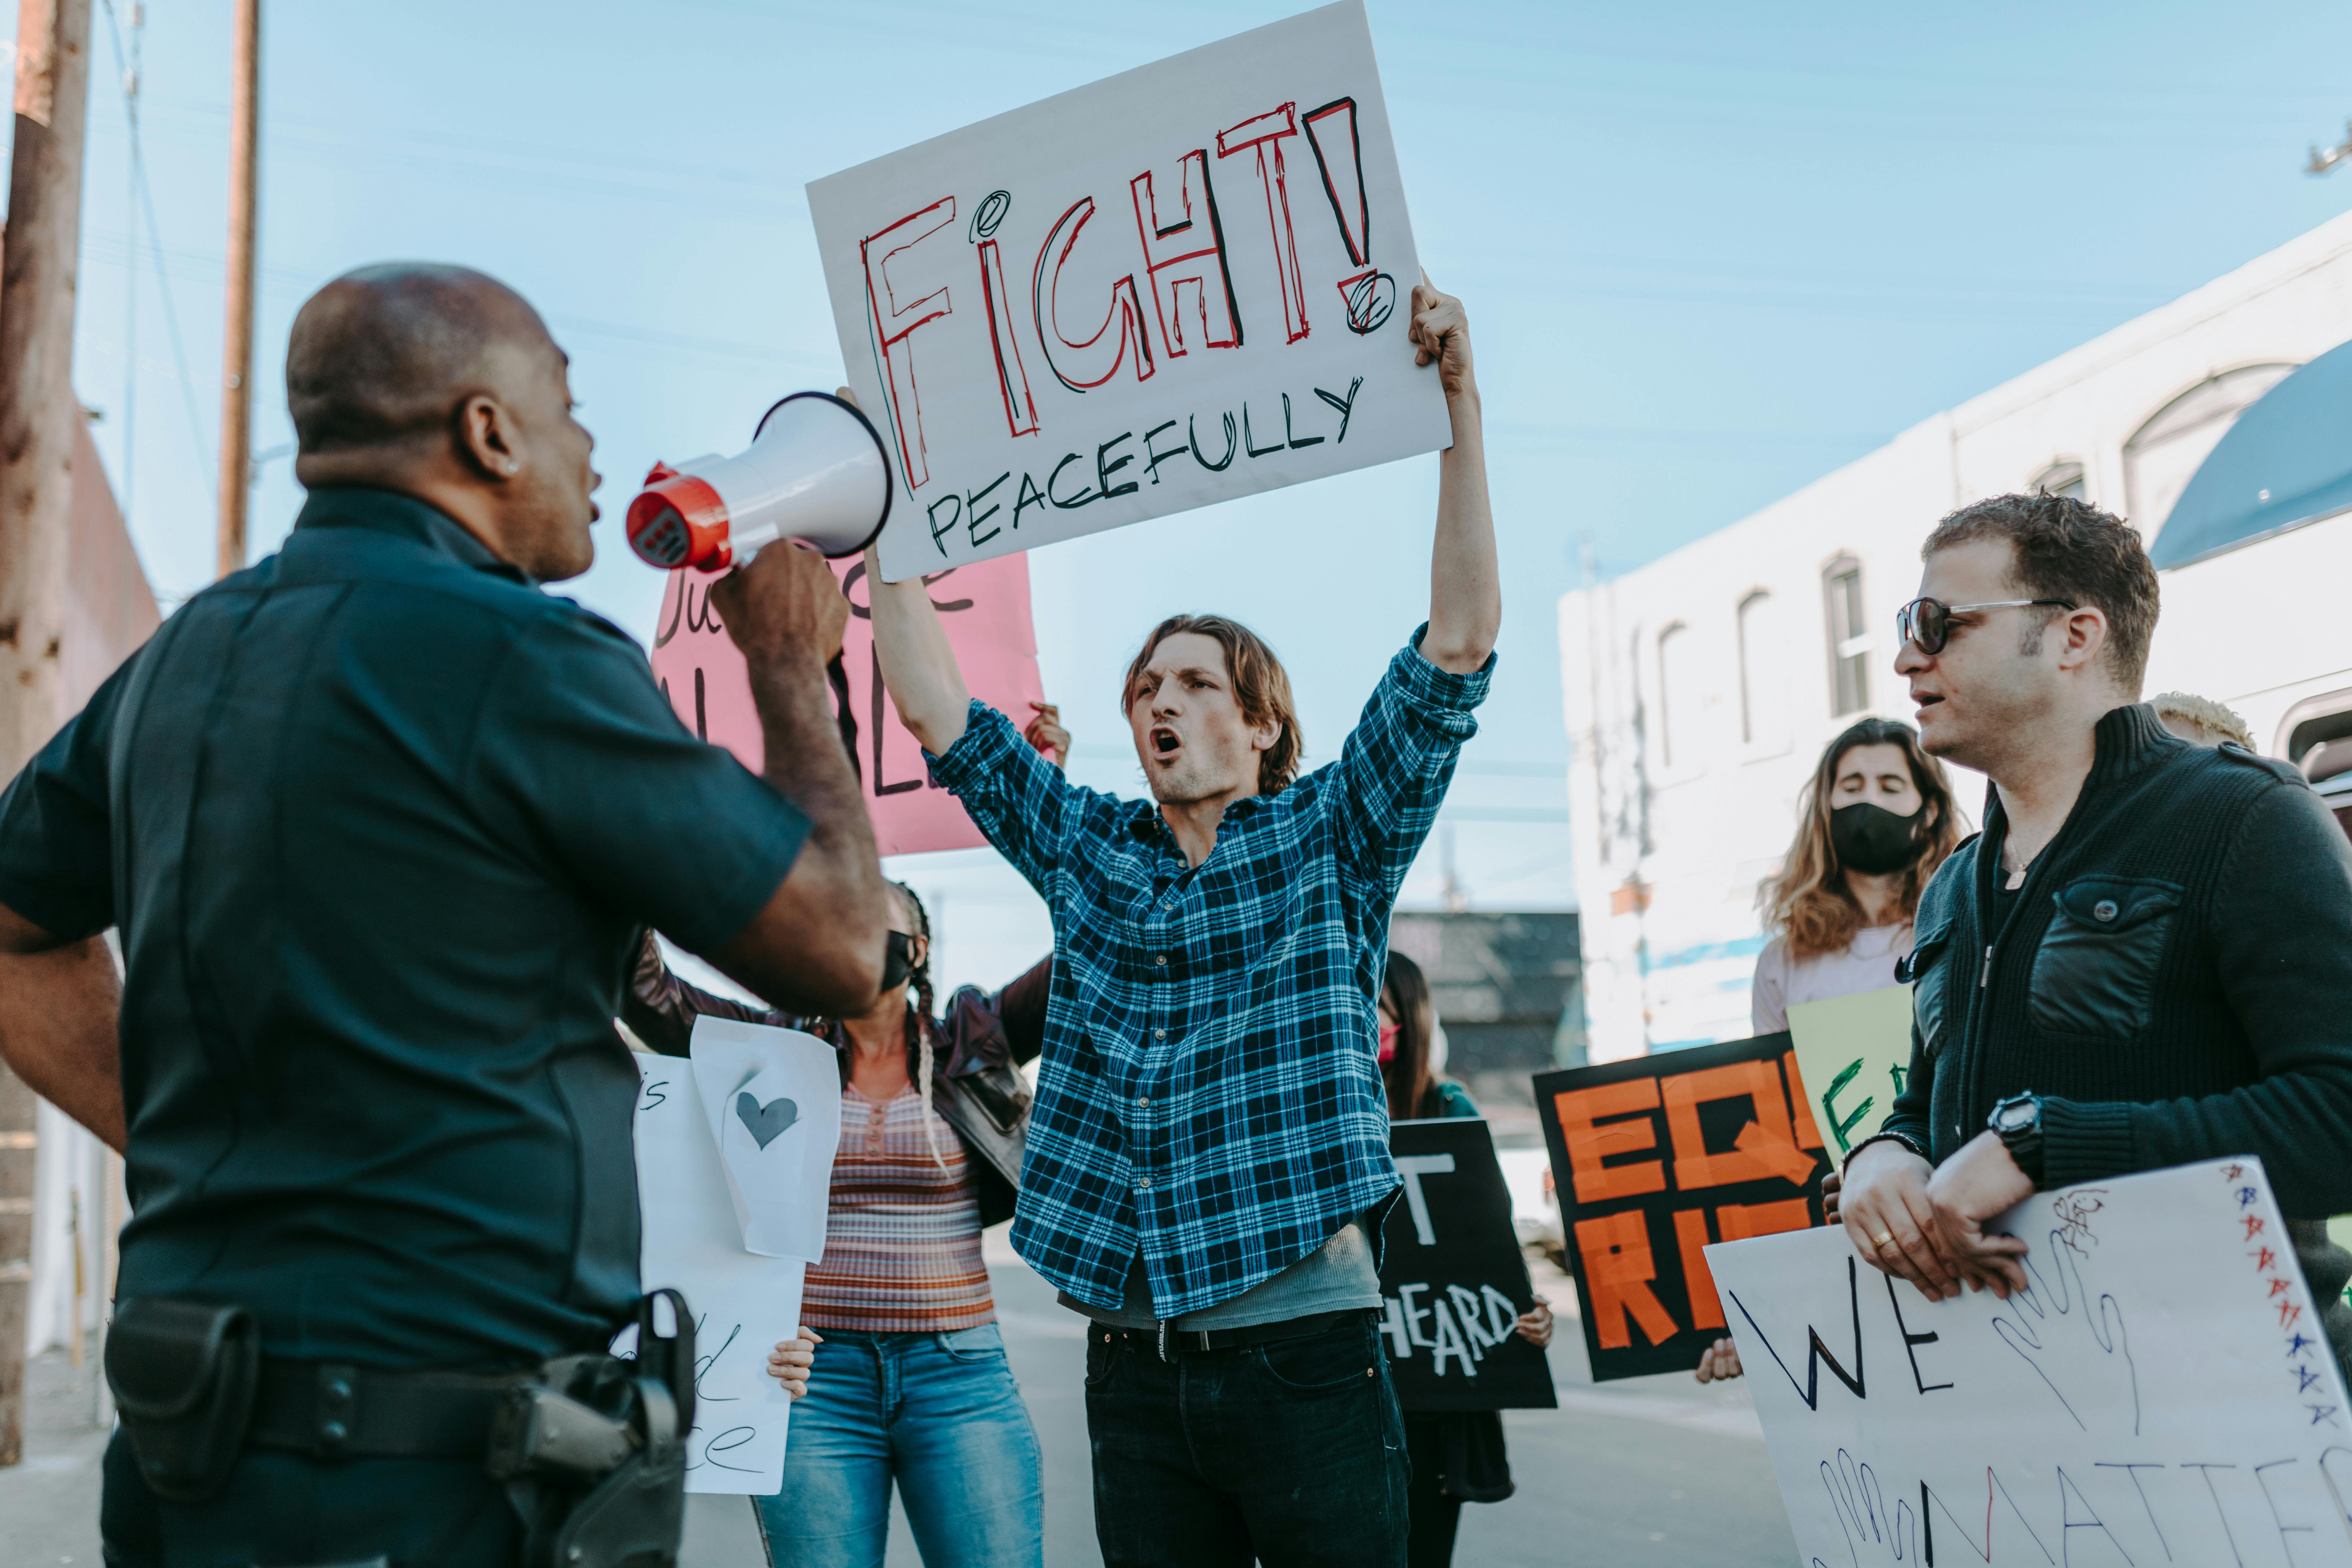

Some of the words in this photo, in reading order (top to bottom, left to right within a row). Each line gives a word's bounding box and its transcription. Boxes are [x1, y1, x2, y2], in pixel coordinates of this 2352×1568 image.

[927, 376, 1364, 558] PEACEFULLY
[1379, 1283, 1519, 1376] HEARD
[1729, 1254, 1954, 1412] WE
